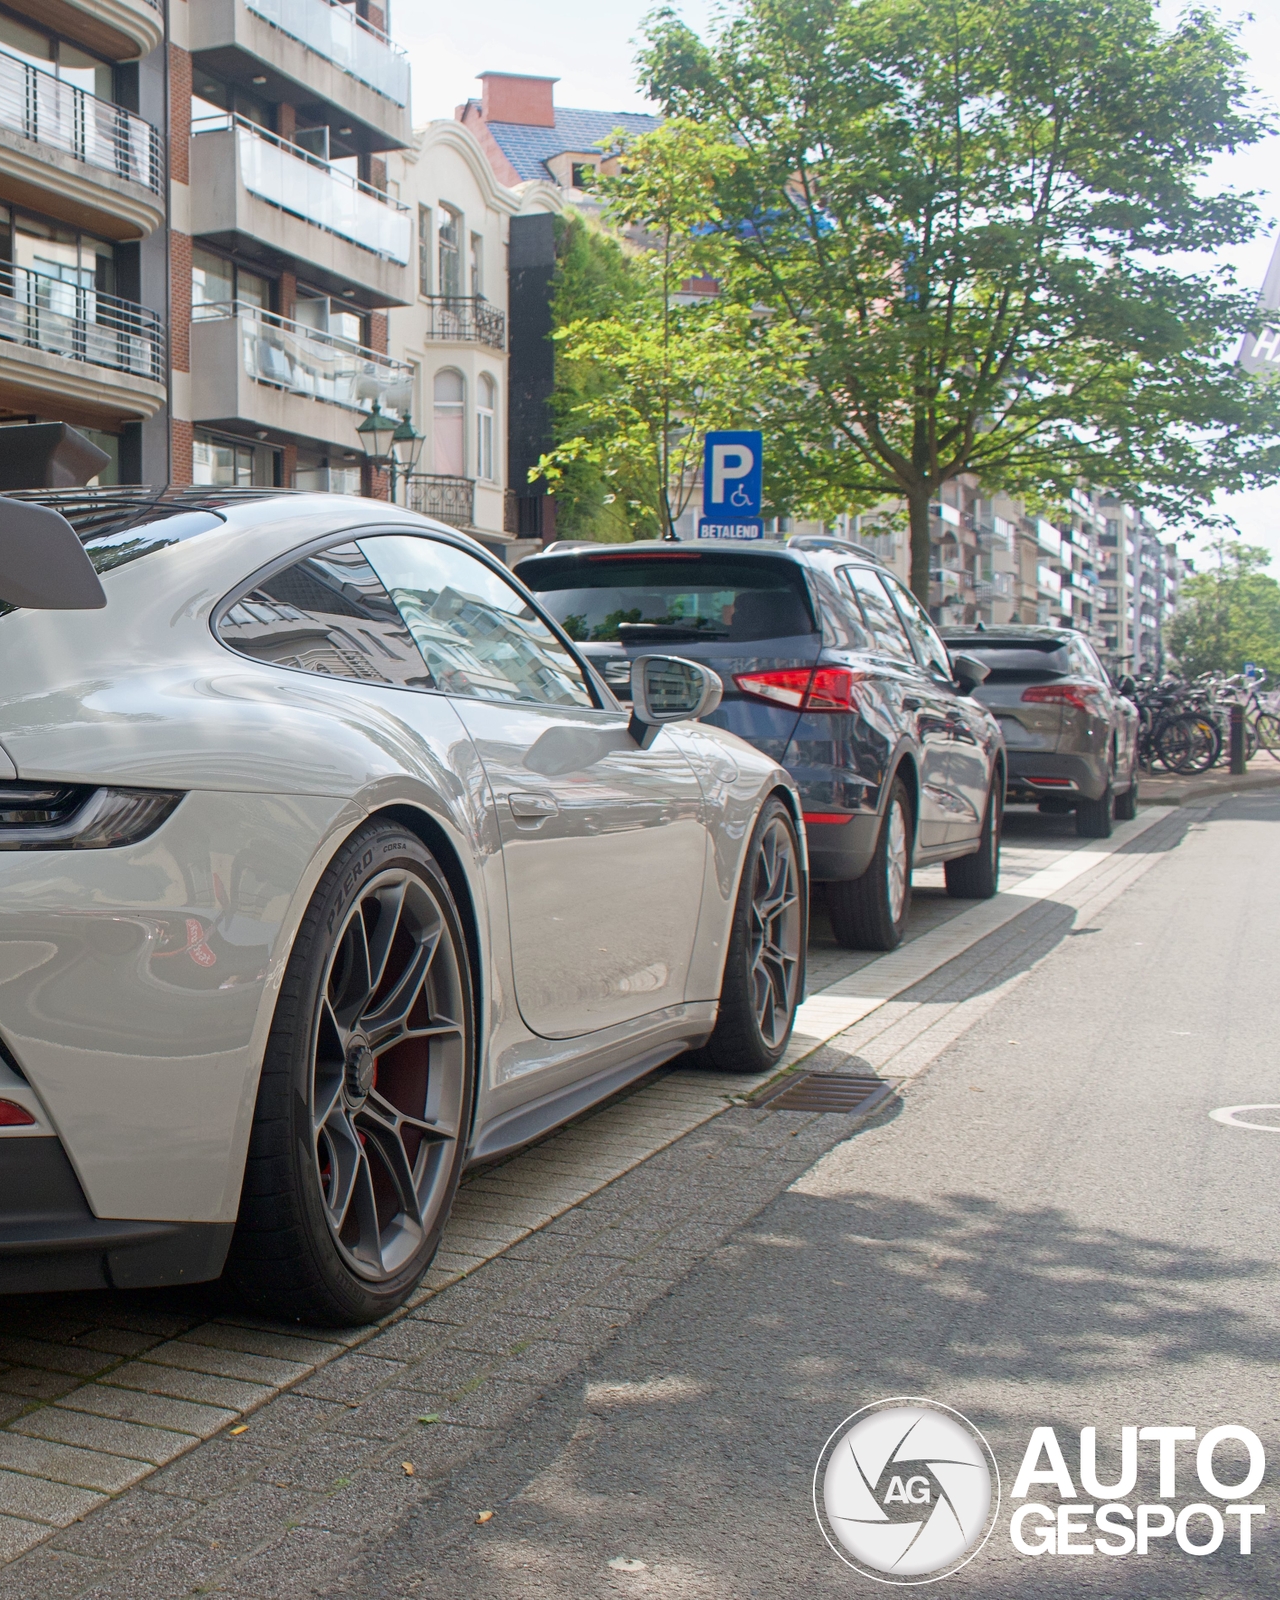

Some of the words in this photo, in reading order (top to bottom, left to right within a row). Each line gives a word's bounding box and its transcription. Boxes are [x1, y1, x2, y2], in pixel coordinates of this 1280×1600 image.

[711, 444, 754, 504] P
[701, 524, 759, 538] BETALEND
[383, 842, 407, 853] CORSA
